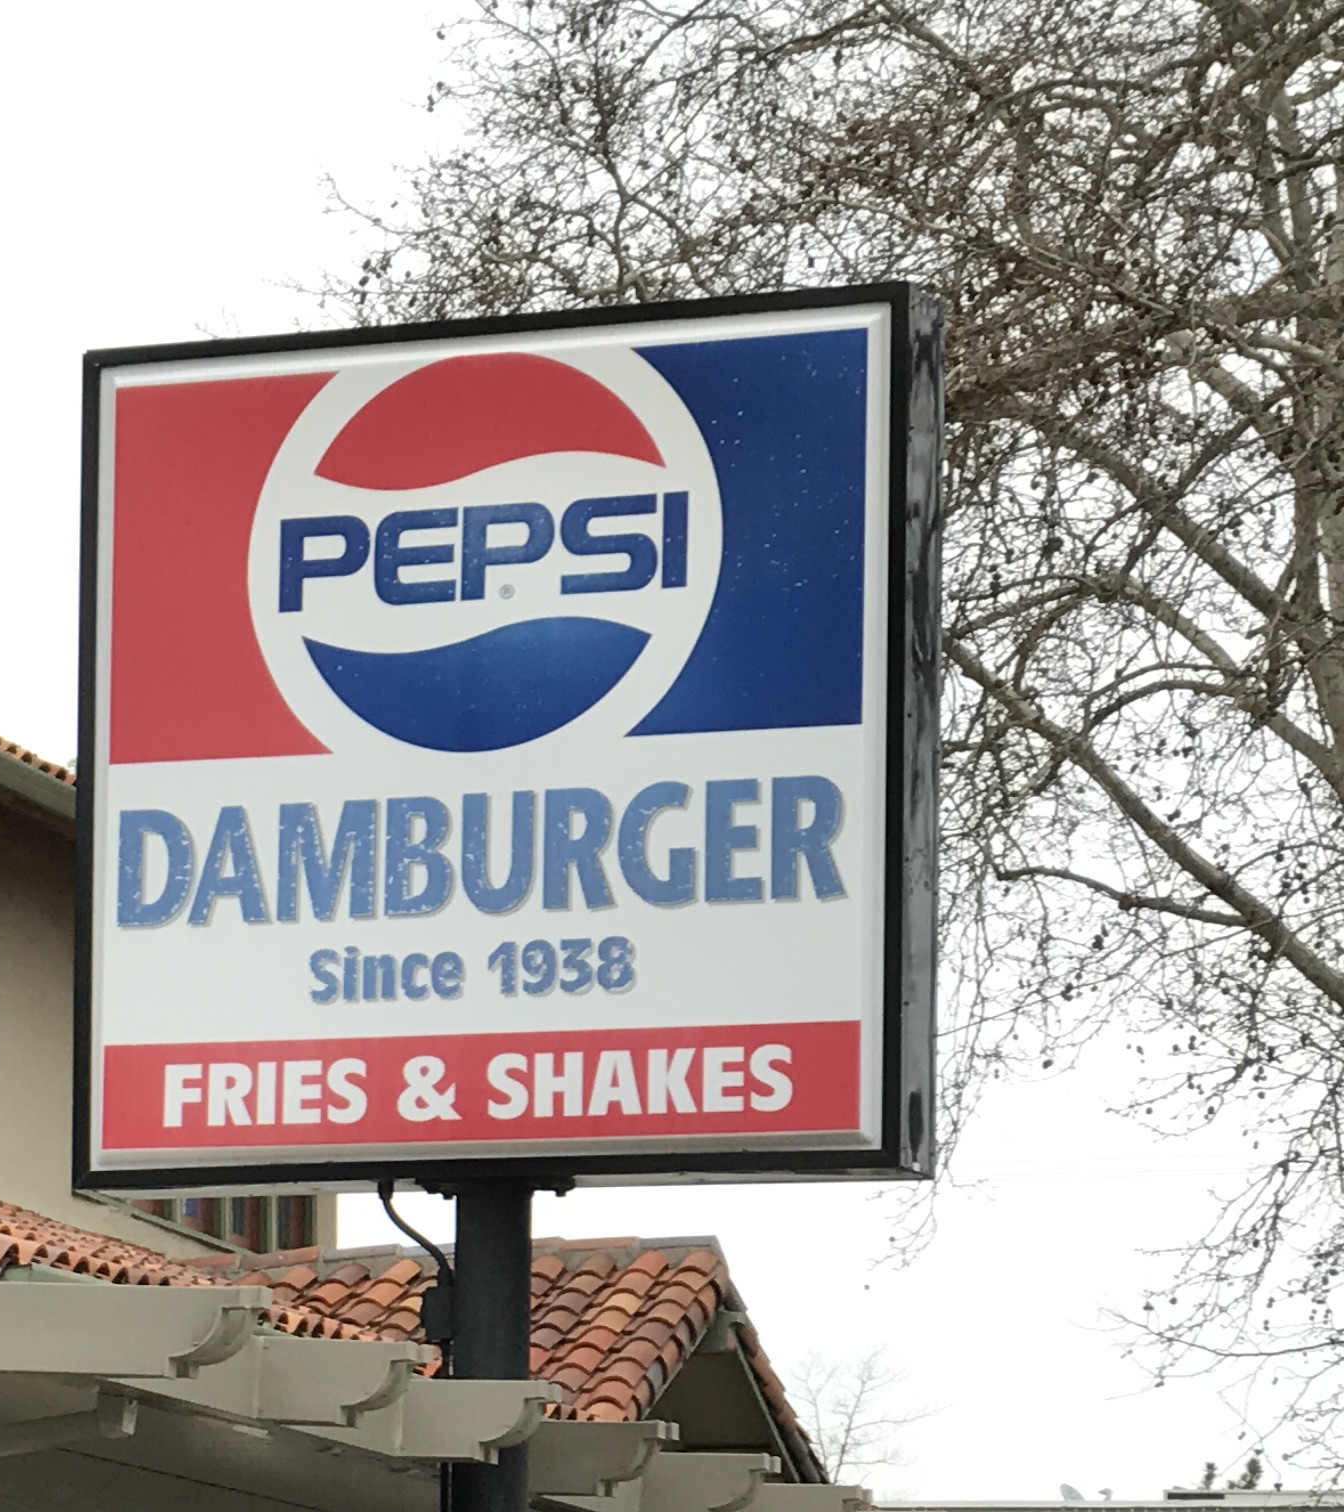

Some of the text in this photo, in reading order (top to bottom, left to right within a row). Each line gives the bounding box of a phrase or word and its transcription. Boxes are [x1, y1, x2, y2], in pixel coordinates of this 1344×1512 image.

[278, 490, 689, 613] PEPSI
[116, 775, 849, 929] DAMBURGER
[309, 935, 635, 1003] Since 1938
[163, 1044, 793, 1128] FRIES & SHAKES
